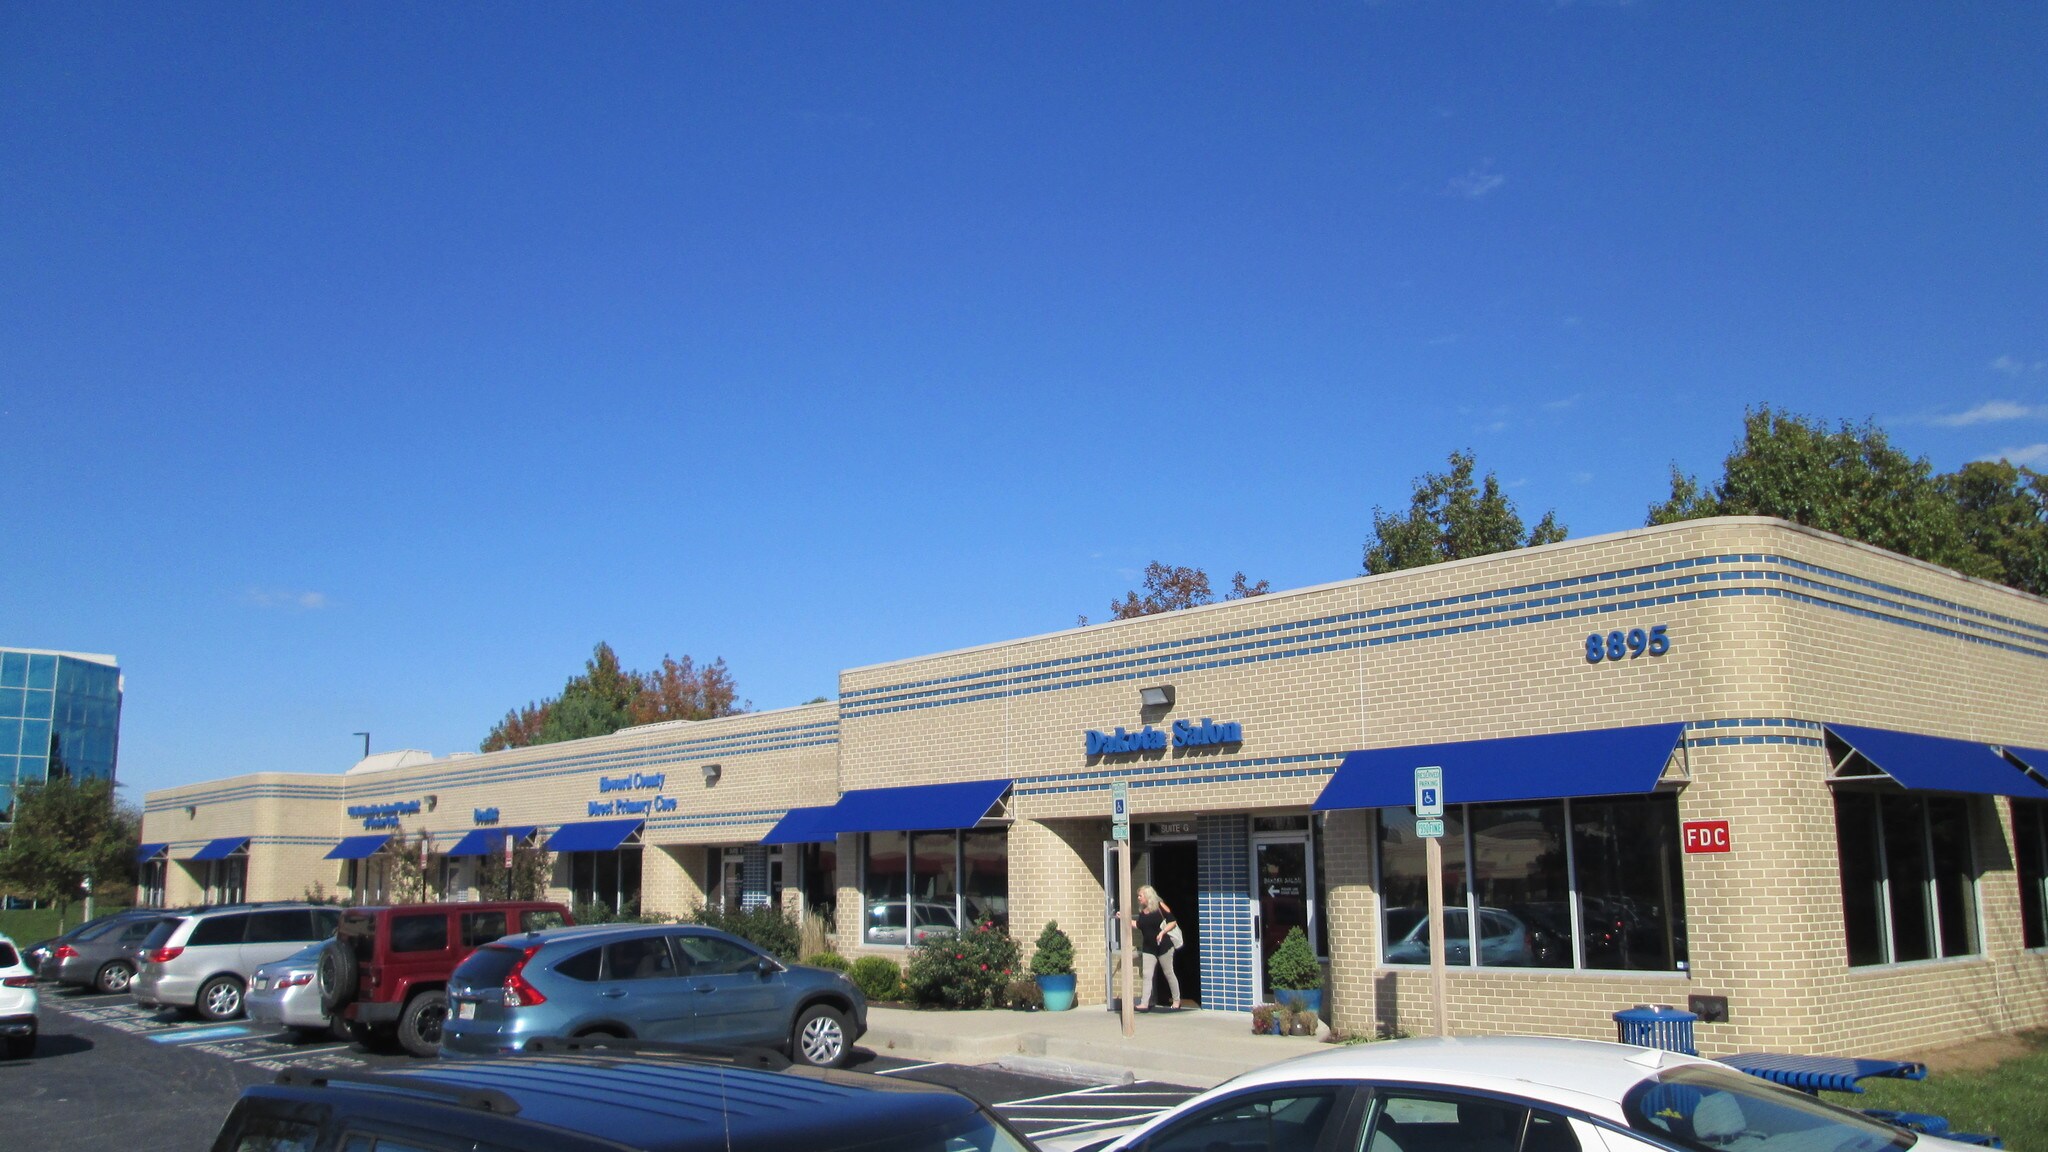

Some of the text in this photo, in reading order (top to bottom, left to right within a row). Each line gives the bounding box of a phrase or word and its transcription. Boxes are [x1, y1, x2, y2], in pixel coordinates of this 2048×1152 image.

[1585, 625, 1670, 664] 8895
[1085, 717, 1243, 756] Dakota Salon
[599, 772, 666, 792] Howard County
[616, 799, 652, 817] Primary
[654, 795, 677, 812] Care
[1161, 824, 1180, 832] SUITE
[1687, 828, 1725, 846] FDC
